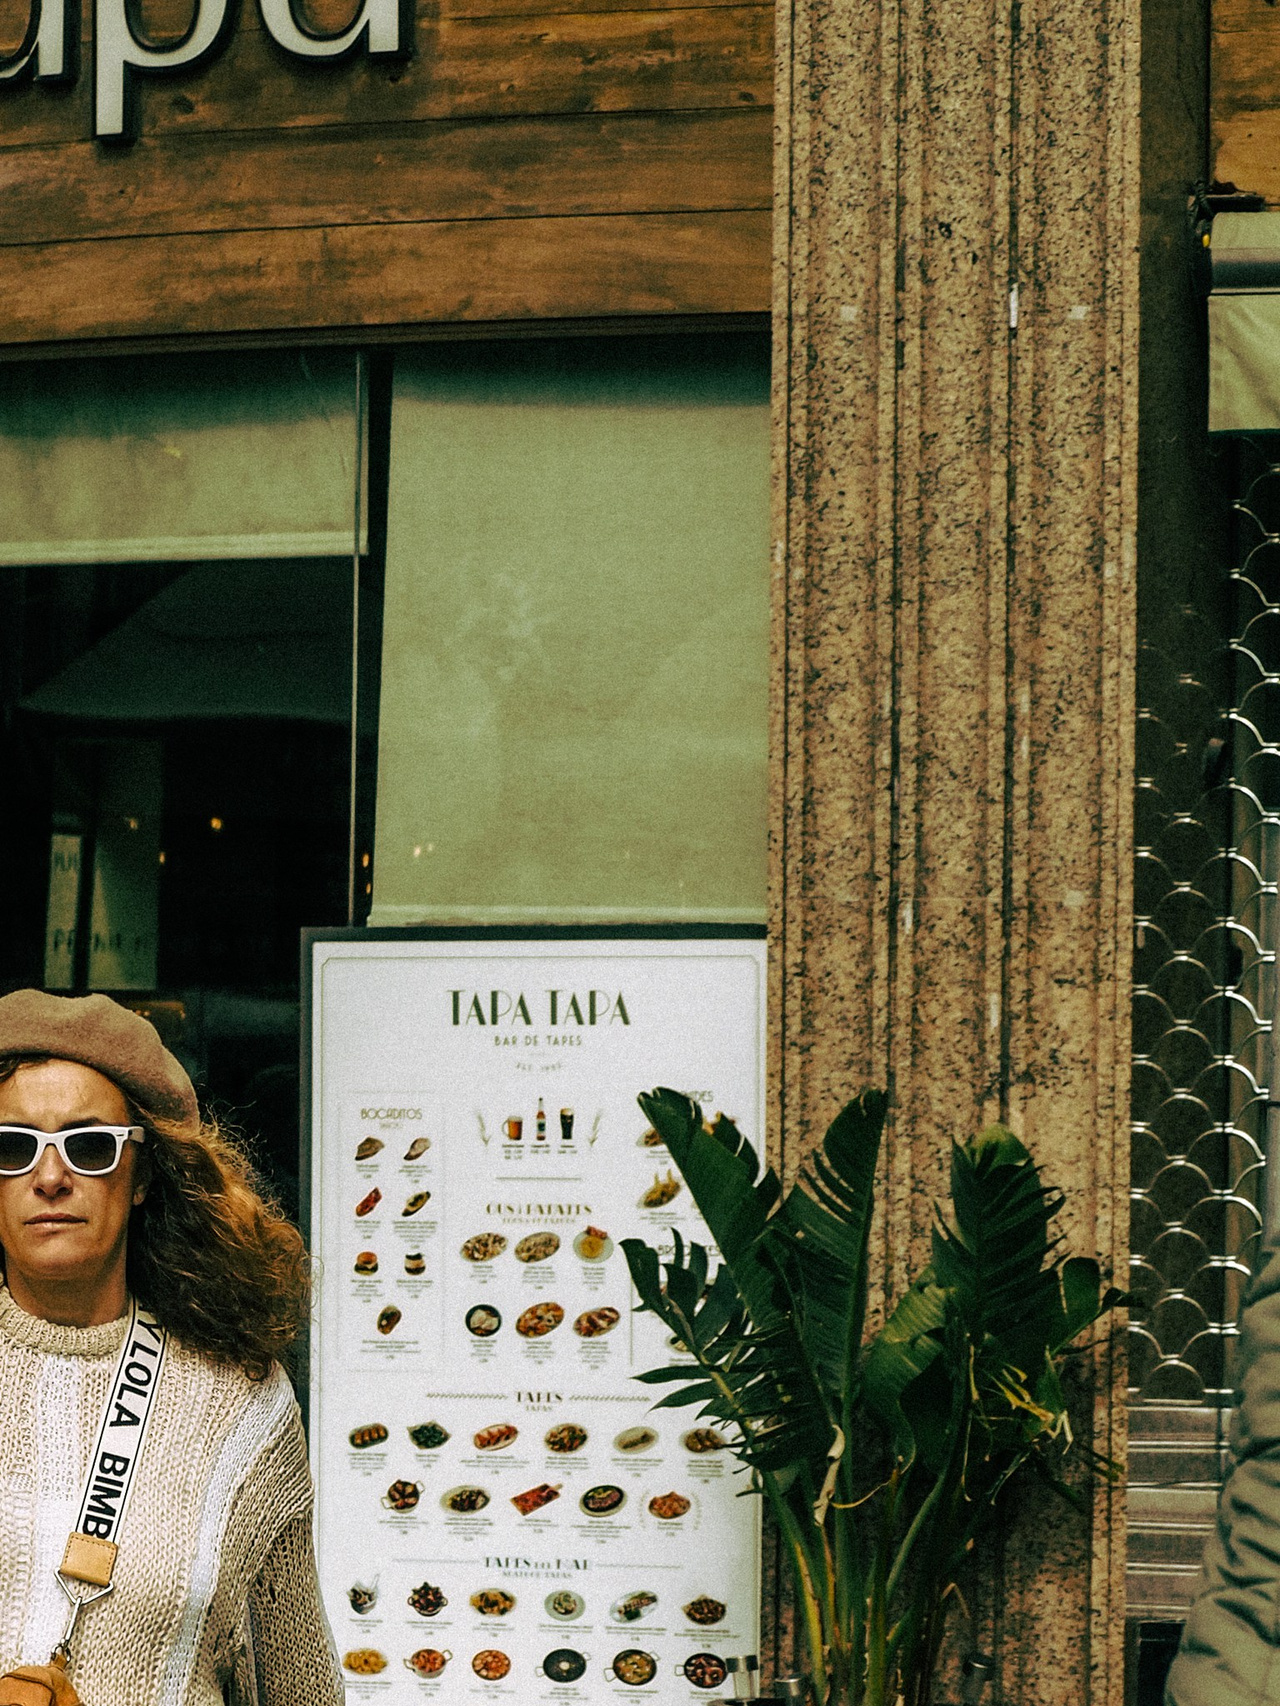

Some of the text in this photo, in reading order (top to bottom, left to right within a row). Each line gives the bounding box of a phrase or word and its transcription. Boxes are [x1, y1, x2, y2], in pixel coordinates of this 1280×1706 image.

[447, 989, 630, 1025] TAPA TAPA
[494, 1035, 582, 1046] BAR DE TAPES
[109, 1340, 158, 1427] LOLA
